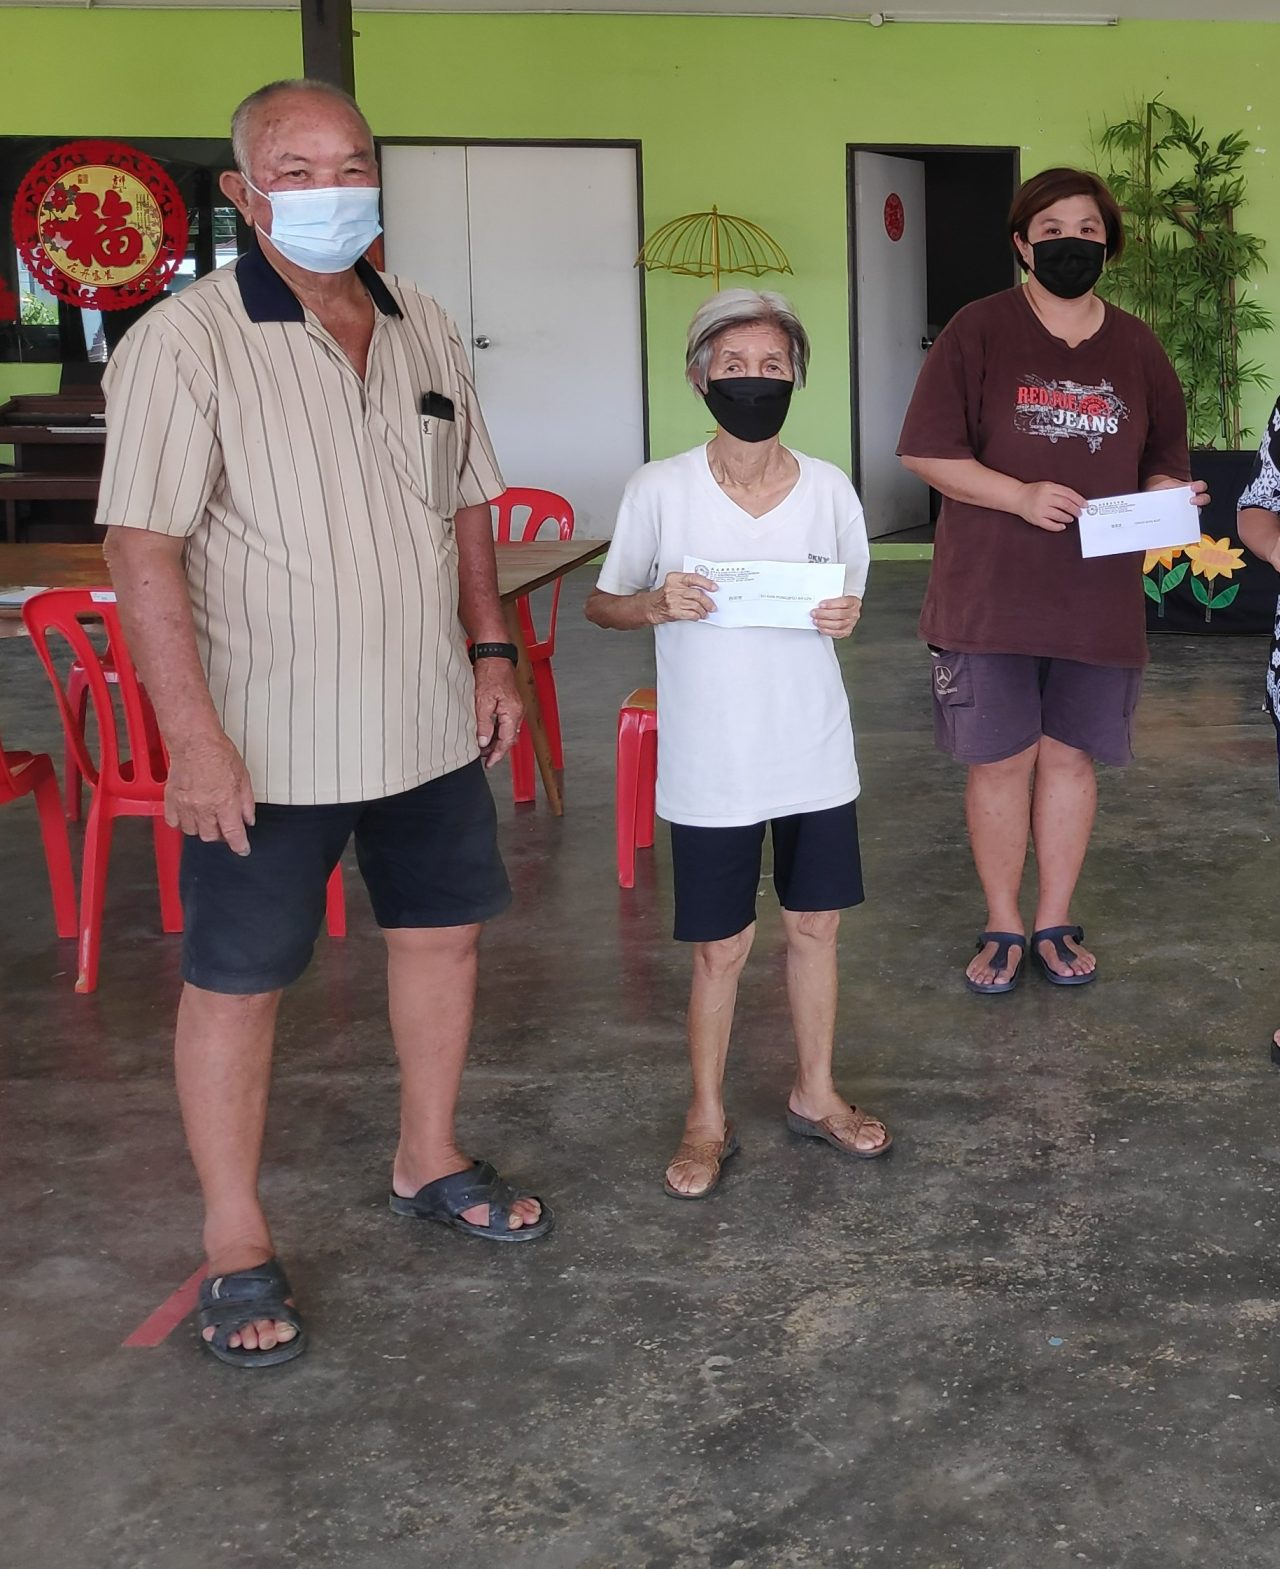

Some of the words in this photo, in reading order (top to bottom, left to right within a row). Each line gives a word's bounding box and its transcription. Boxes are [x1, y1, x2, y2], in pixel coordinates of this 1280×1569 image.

[62, 189, 144, 268] 福
[1017, 386, 1049, 406] RED
[1053, 409, 1119, 435] JEANS
